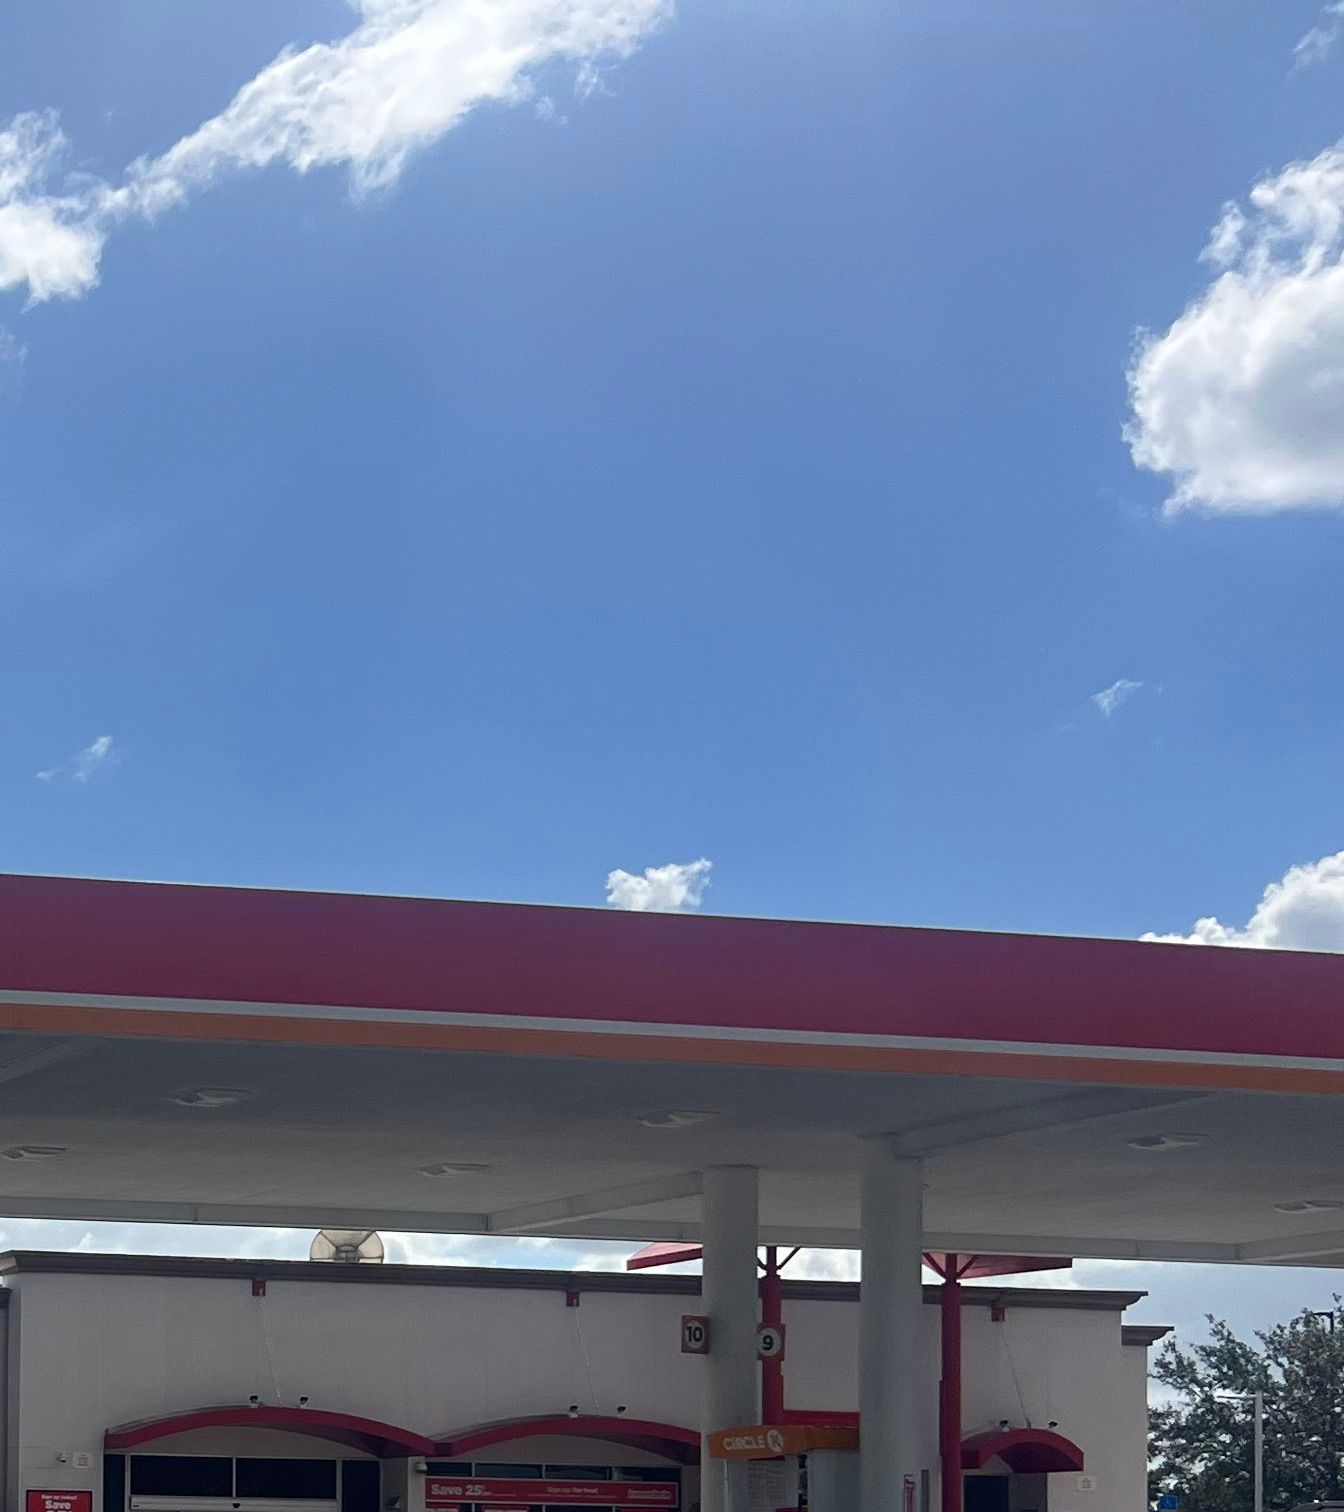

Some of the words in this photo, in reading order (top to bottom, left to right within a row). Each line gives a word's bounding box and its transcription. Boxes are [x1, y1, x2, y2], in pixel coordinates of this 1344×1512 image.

[686, 1326, 703, 1342] 10
[762, 1335, 773, 1351] 9
[431, 1484, 463, 1496] Save
